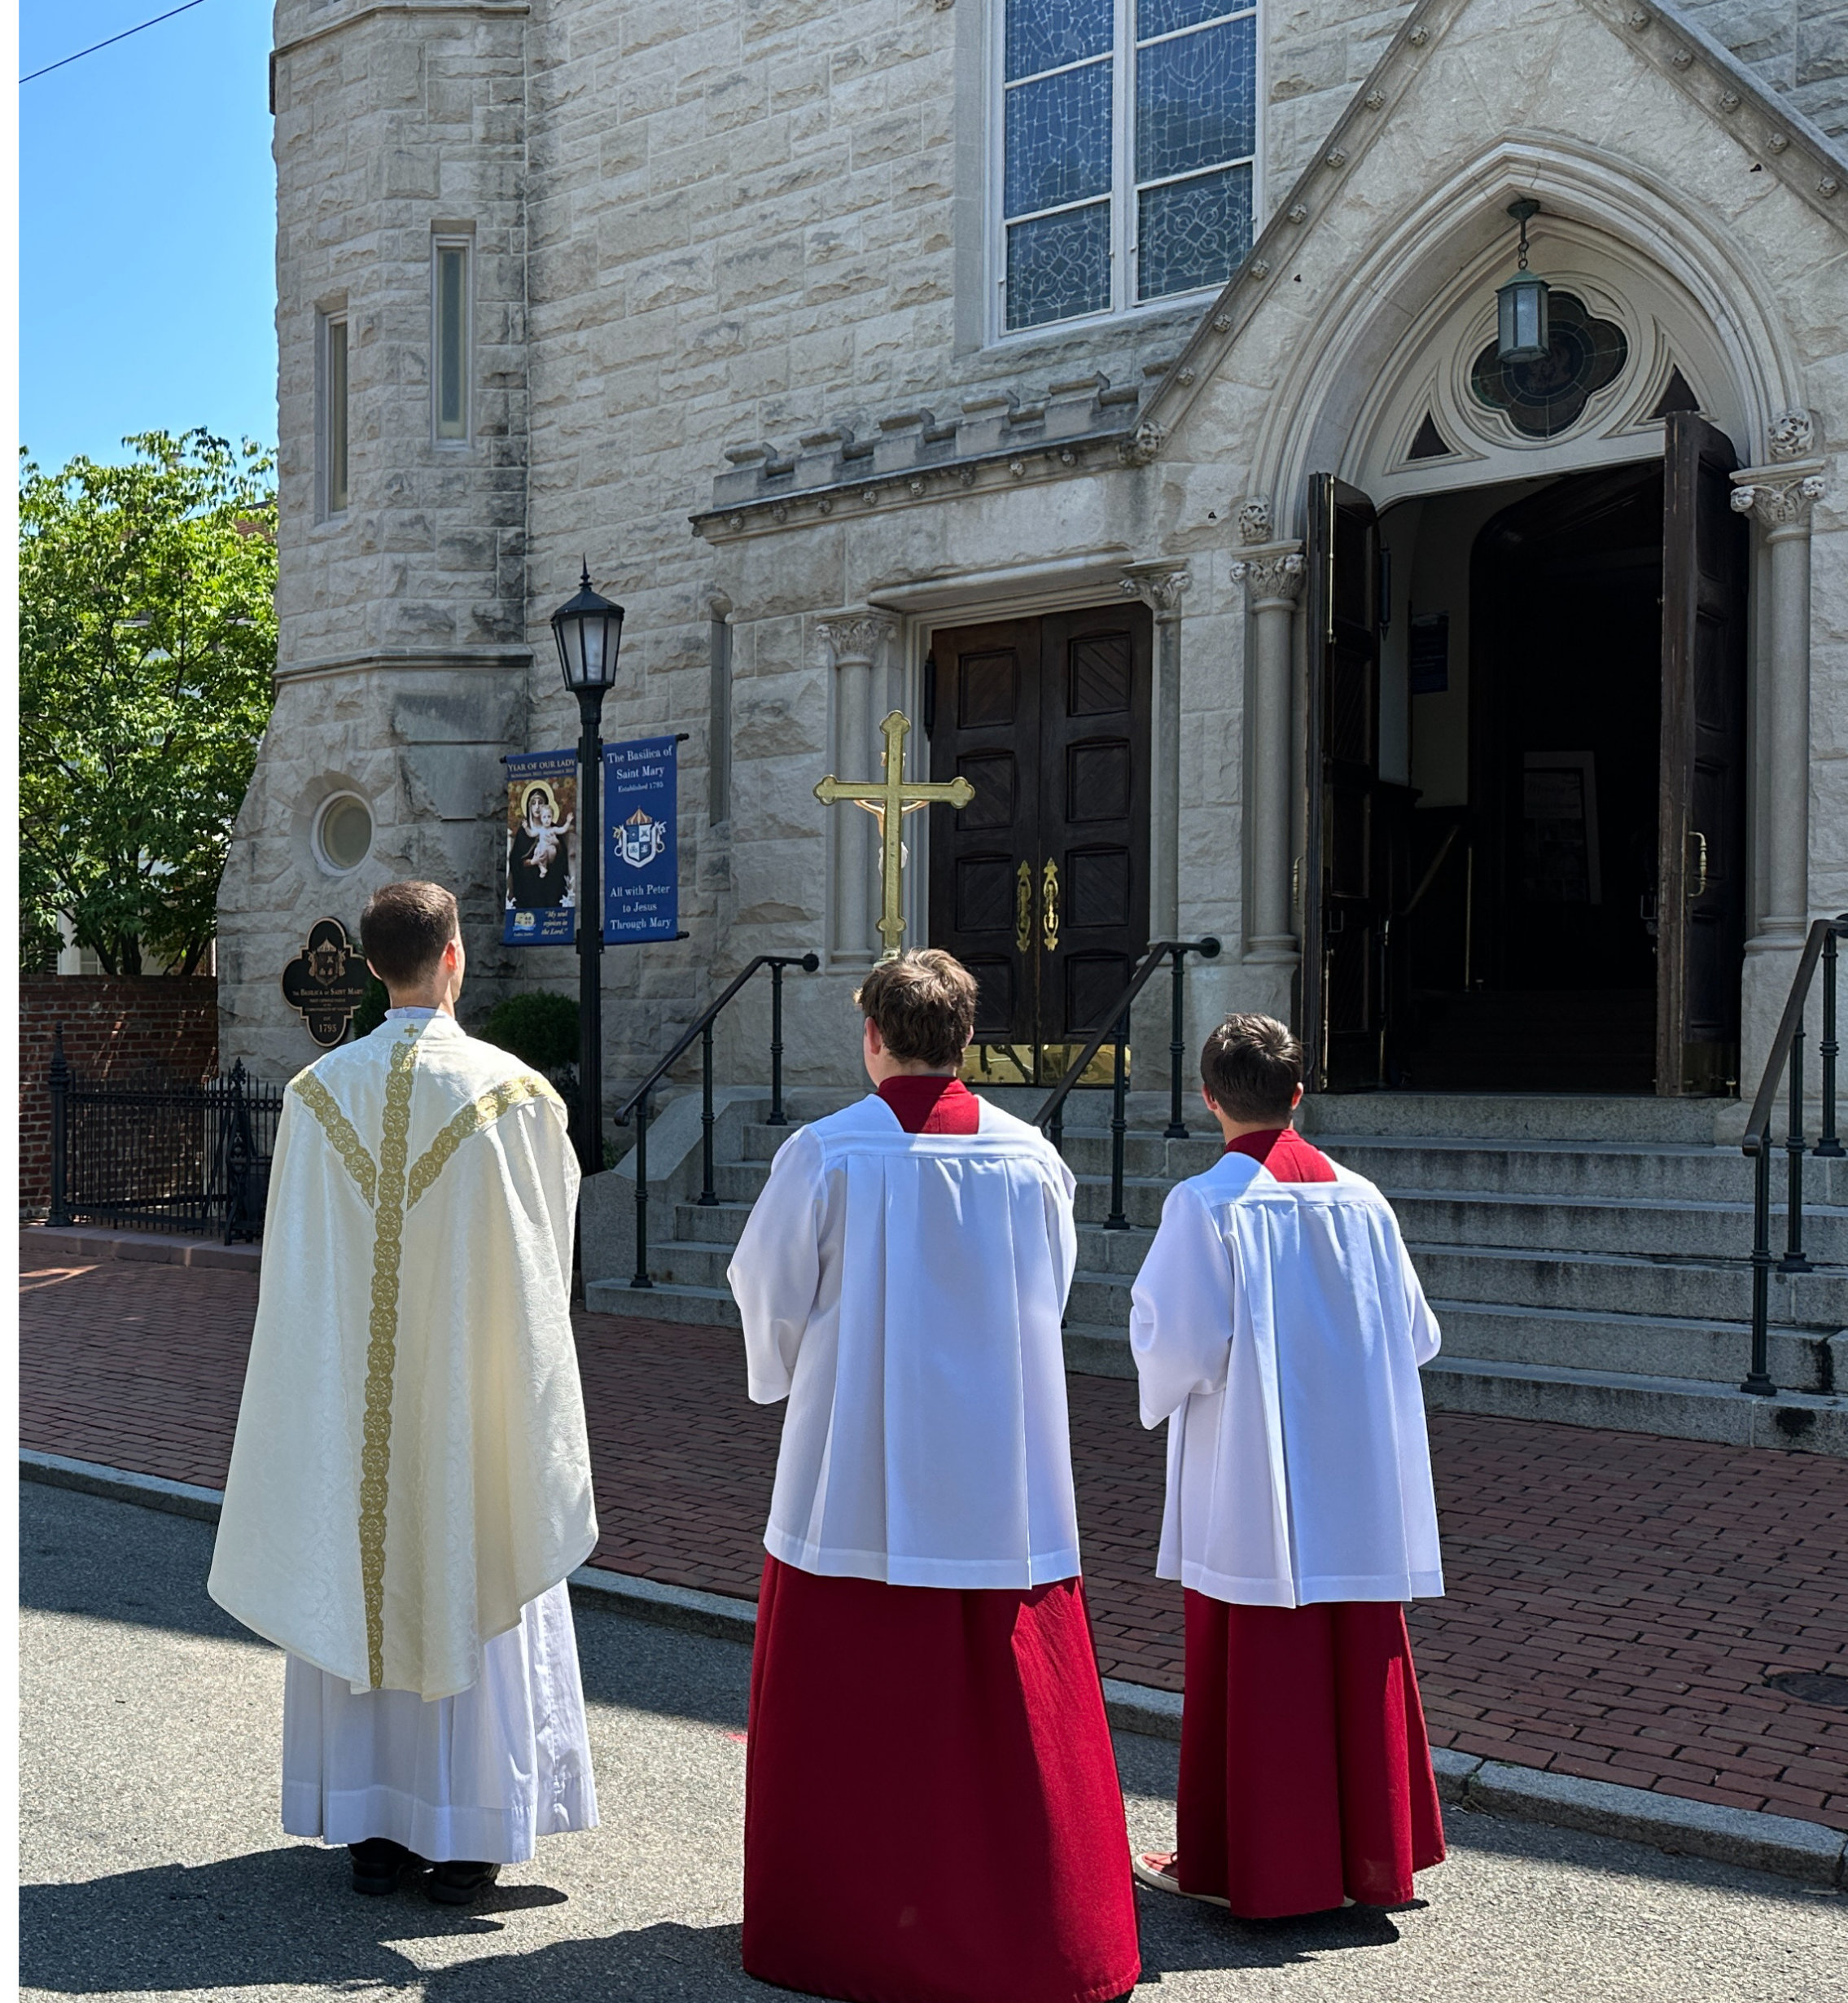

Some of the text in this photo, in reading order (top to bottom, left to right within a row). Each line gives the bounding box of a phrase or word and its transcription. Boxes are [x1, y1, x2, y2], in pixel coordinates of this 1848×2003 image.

[607, 745, 673, 764] The Basilica of
[508, 758, 576, 772] YEAR OF OUR LADY
[616, 765, 665, 780] Saint Mary
[618, 781, 663, 792] Established 1795
[610, 884, 670, 897] All with Peter
[623, 901, 658, 913] to Jesus
[610, 917, 672, 931] Through Mary
[318, 1023, 337, 1033] 1795
